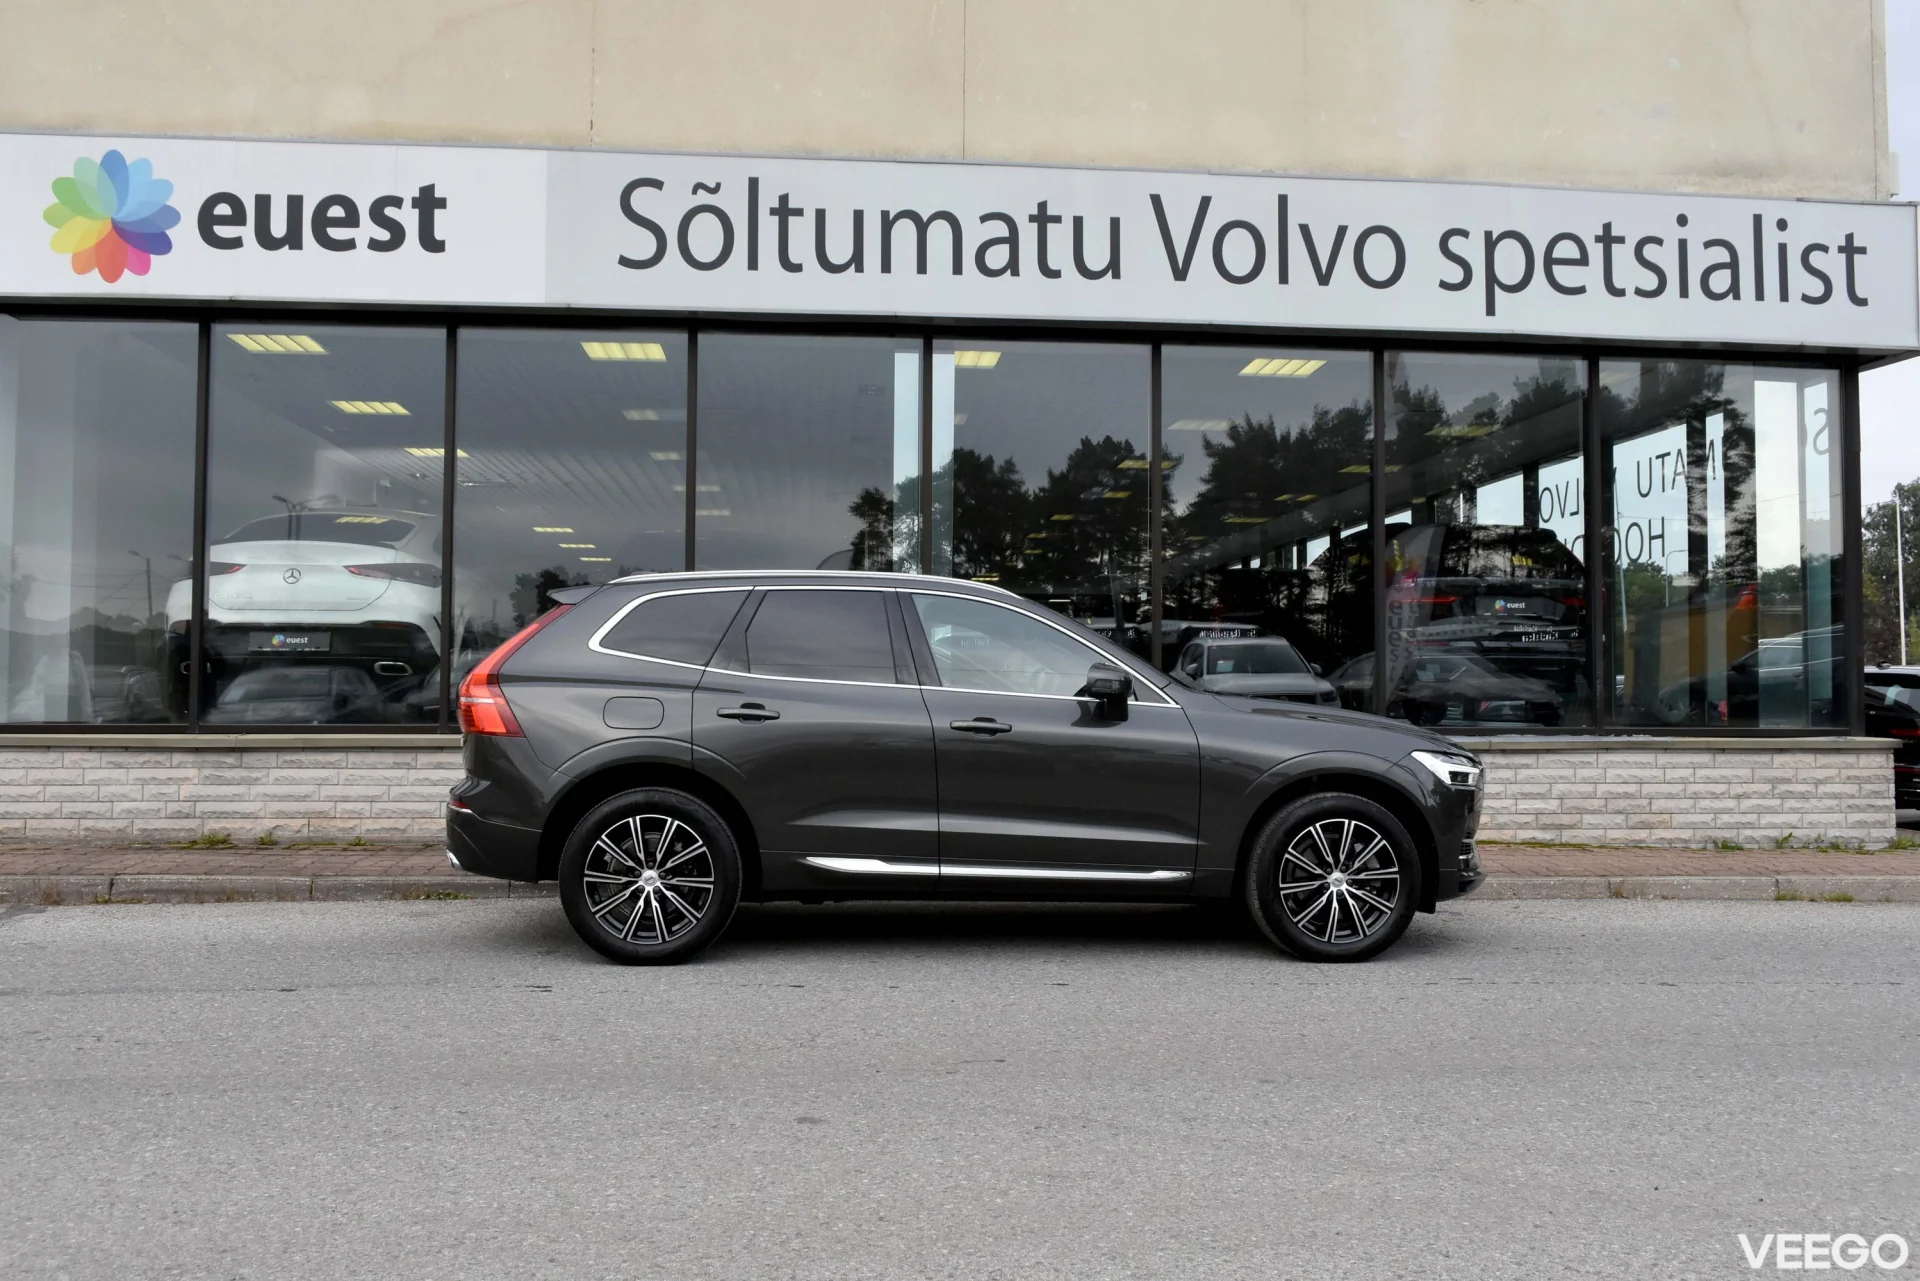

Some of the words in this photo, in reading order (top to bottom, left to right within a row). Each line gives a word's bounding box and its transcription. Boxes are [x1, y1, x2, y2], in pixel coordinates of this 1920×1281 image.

[197, 183, 447, 256] euest
[617, 177, 1121, 281] Sõltumatu
[1149, 193, 1406, 290] Volvo
[1438, 213, 1869, 317] spetsialist
[1506, 601, 1526, 609] euest
[286, 636, 309, 644] euest
